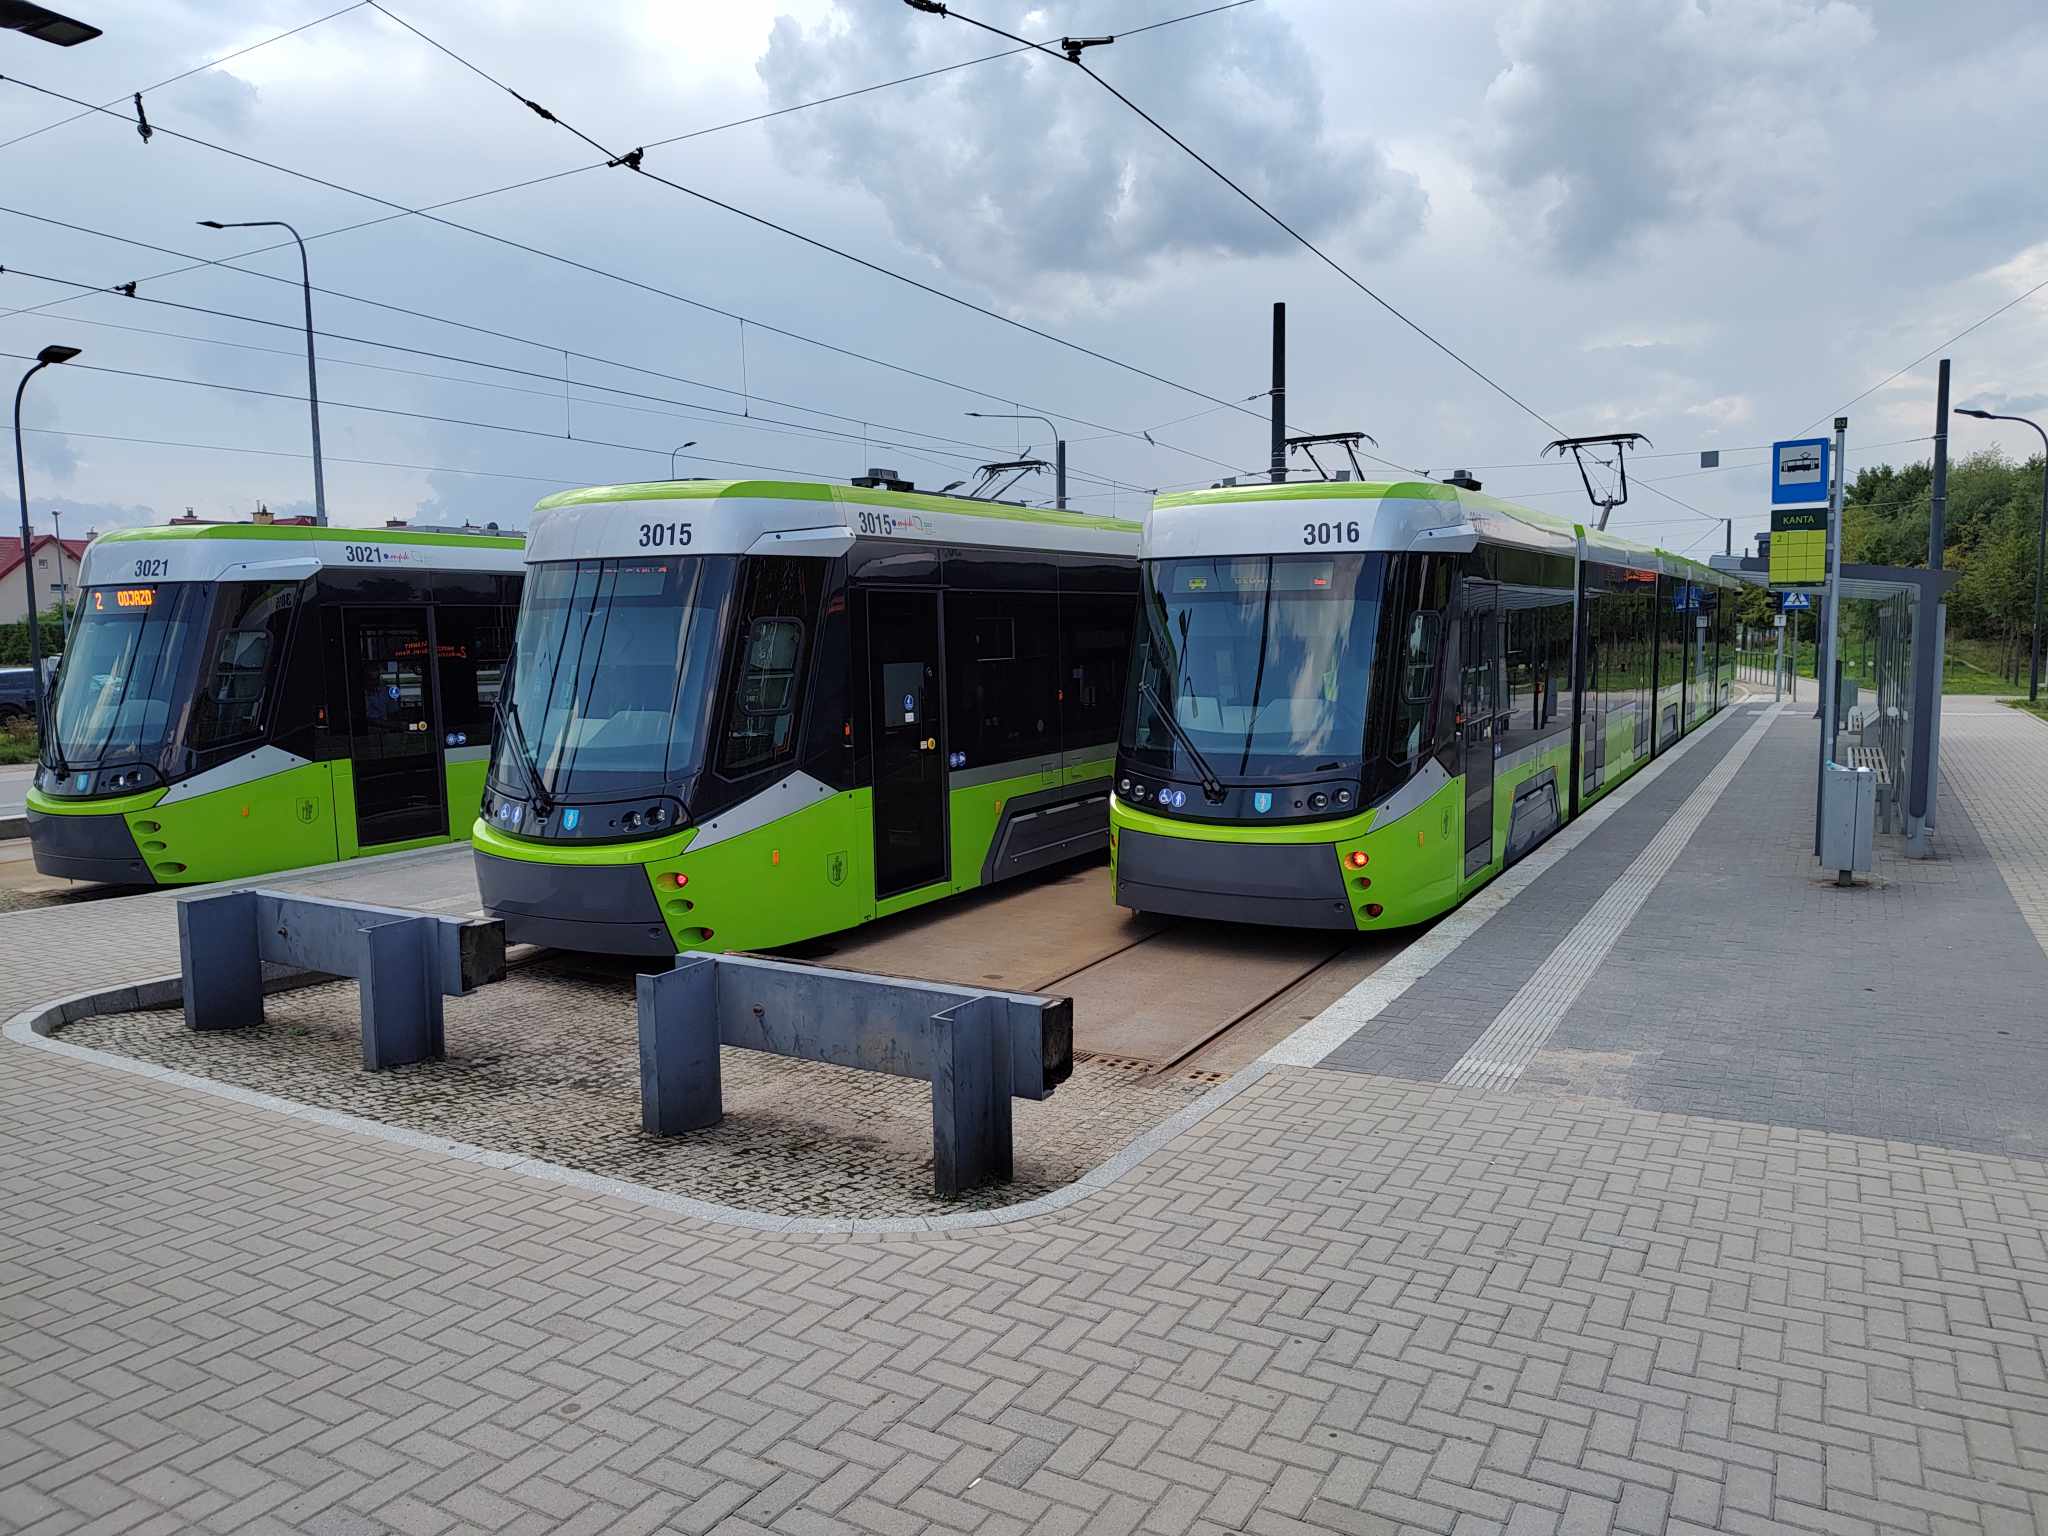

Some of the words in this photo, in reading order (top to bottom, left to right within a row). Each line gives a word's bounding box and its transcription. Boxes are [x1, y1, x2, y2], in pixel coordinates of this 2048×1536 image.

[859, 511, 892, 535] 3015
[1782, 515, 1816, 525] KANTA
[639, 522, 693, 547] 3015
[1303, 521, 1360, 546] 3016
[345, 545, 382, 563] 3021
[134, 559, 169, 577] 3021
[95, 592, 103, 610] 2
[117, 590, 152, 606] ODJAZD
